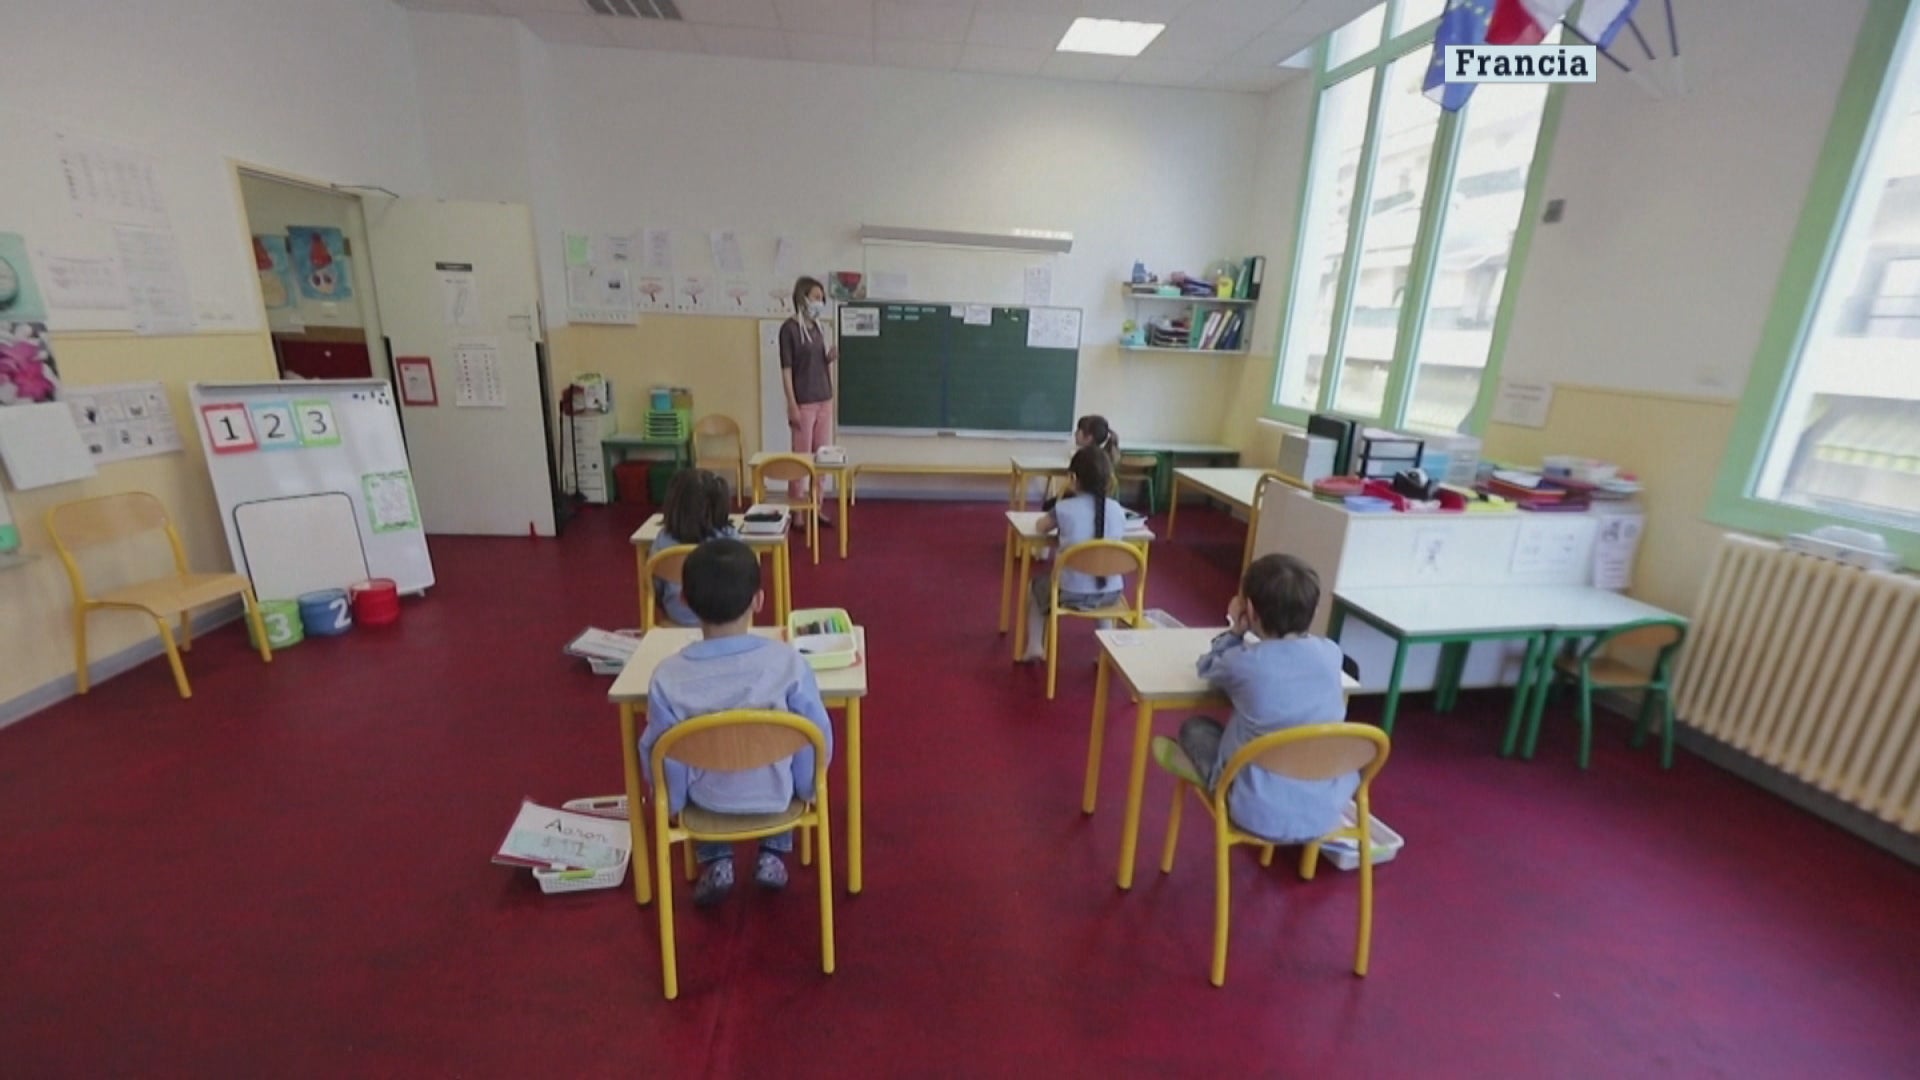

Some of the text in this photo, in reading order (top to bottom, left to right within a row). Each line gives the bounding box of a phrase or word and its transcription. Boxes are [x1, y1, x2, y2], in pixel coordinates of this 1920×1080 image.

[219, 411, 328, 441] 1 2 3
[266, 614, 291, 642] 3
[330, 599, 351, 628] 2
